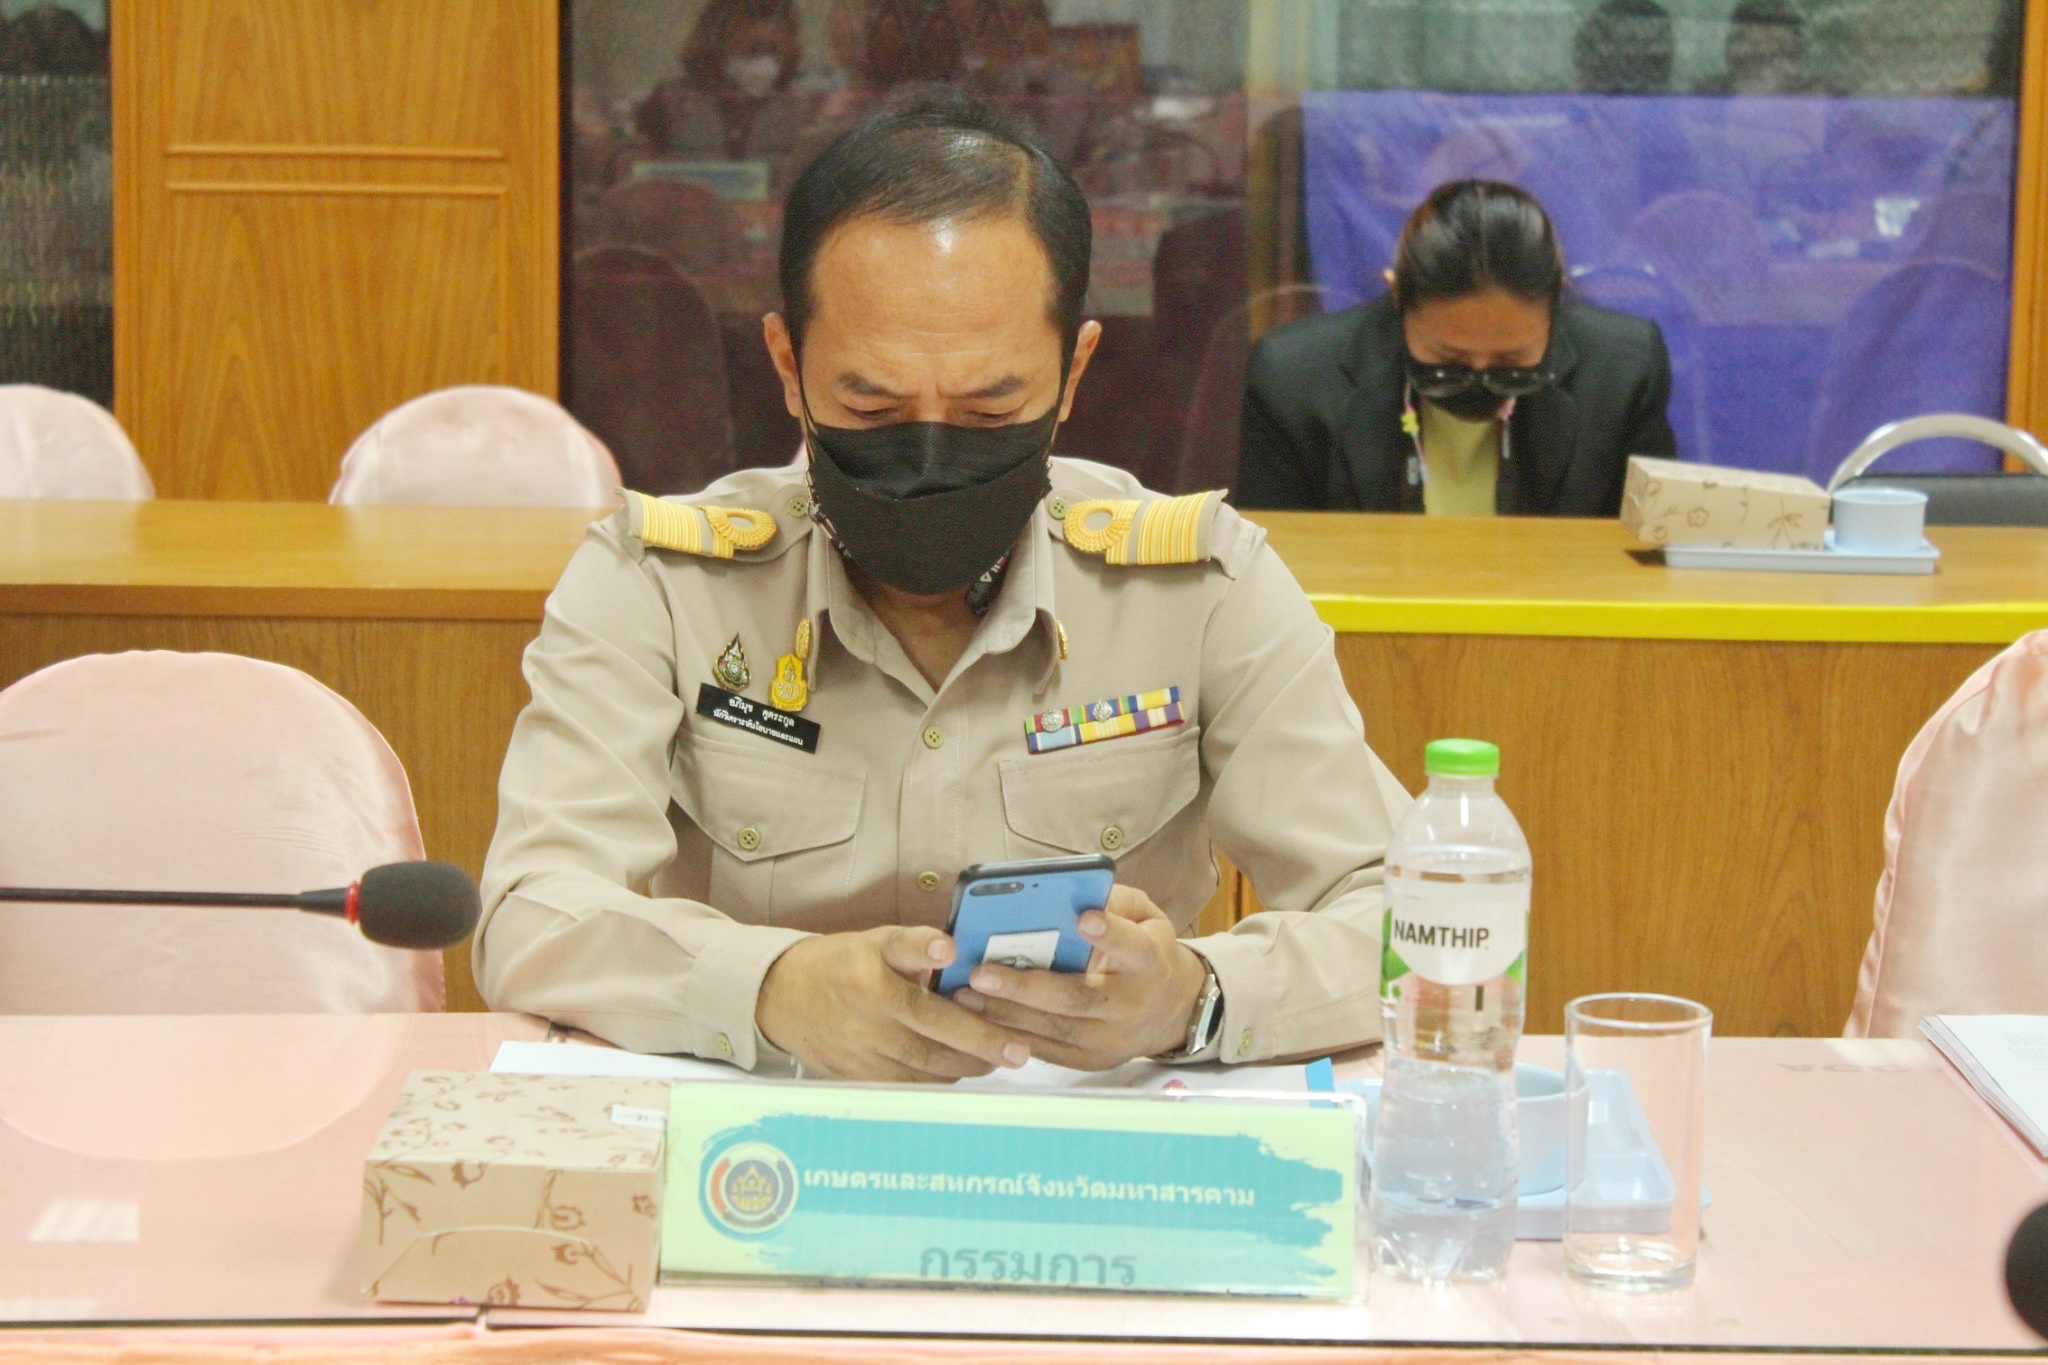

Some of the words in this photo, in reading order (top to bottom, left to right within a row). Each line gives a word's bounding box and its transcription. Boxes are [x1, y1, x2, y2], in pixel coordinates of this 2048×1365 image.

[1393, 918, 1490, 949] NAMTHIP
[803, 1167, 1255, 1207] เกษตรและสหกรณ์จังหวัดมหาสารคาม
[919, 1246, 1138, 1287] กรรมการ
